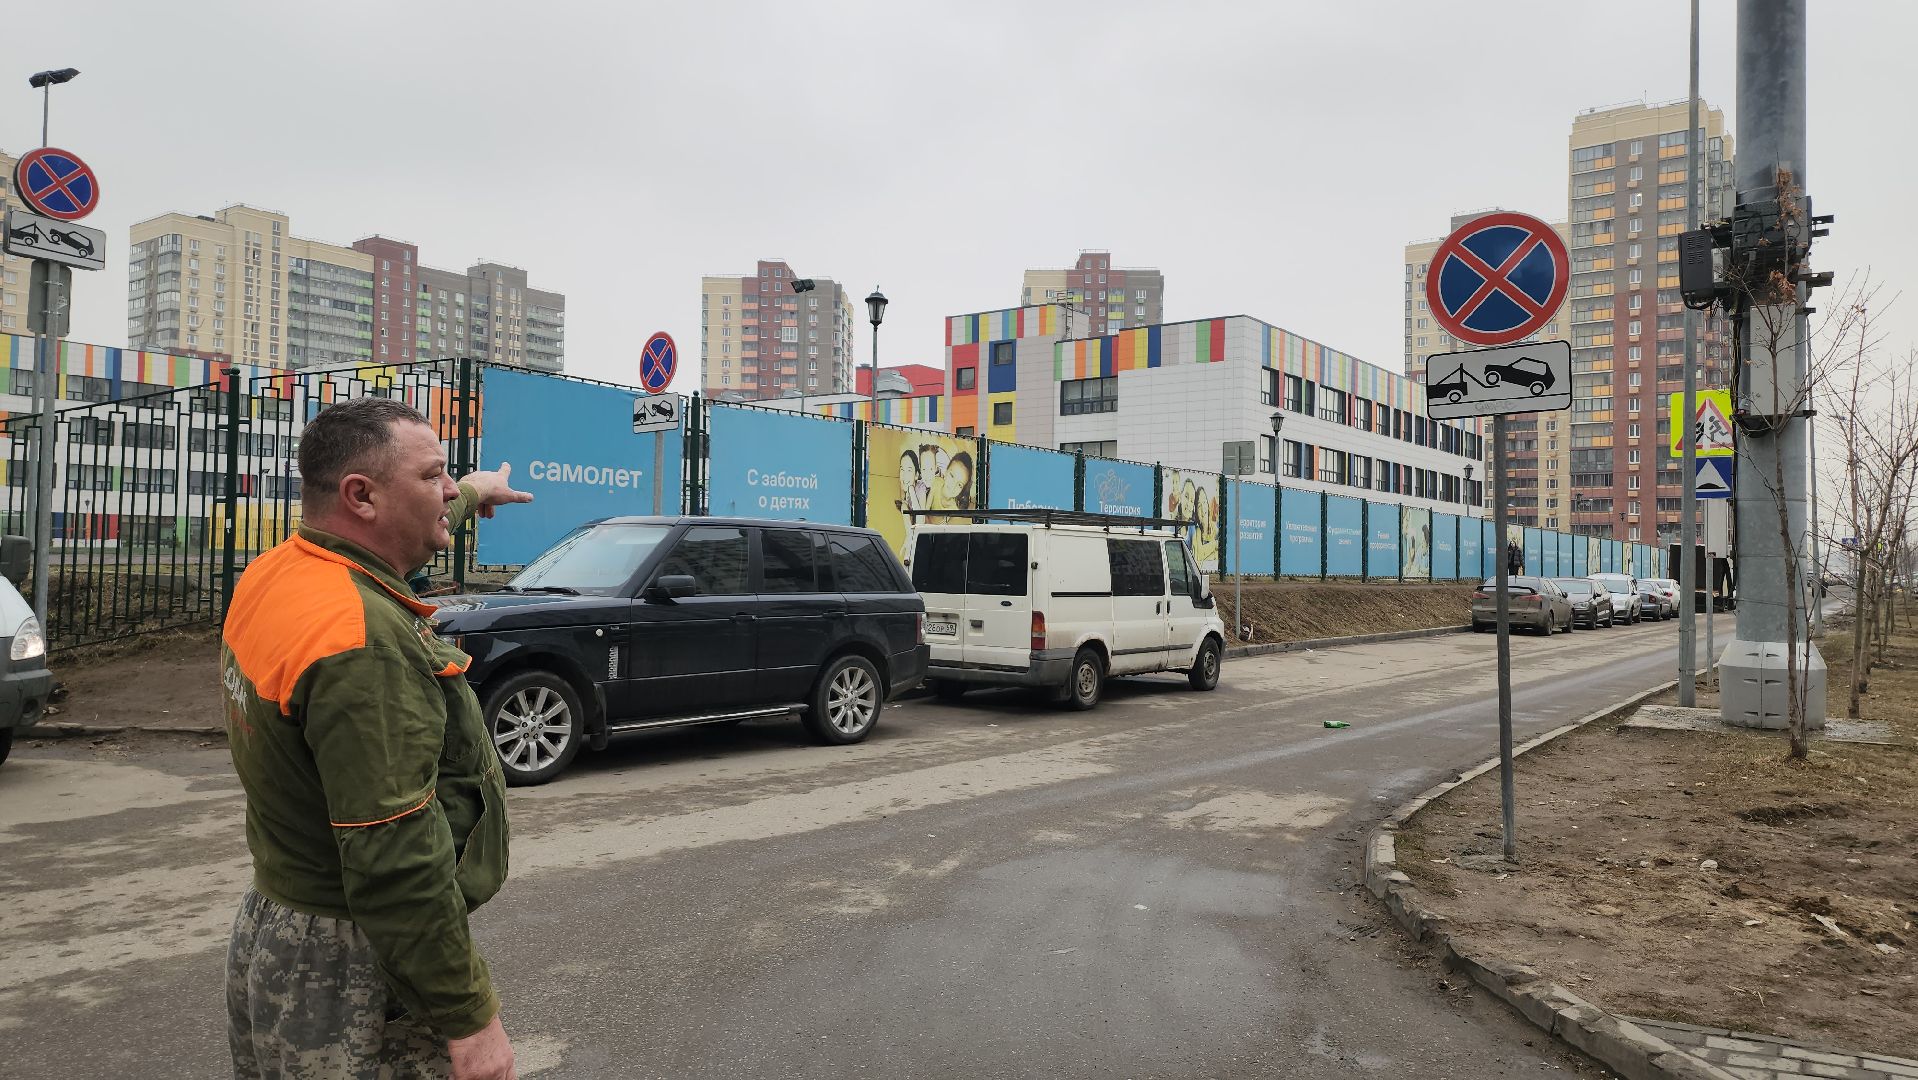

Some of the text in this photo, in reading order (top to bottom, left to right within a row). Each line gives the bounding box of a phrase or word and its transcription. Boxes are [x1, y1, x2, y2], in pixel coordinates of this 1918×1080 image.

[529, 460, 643, 489] самолет
[747, 469, 818, 489] С заботой
[758, 496, 810, 510] о детях
[1099, 501, 1141, 516] Территория
